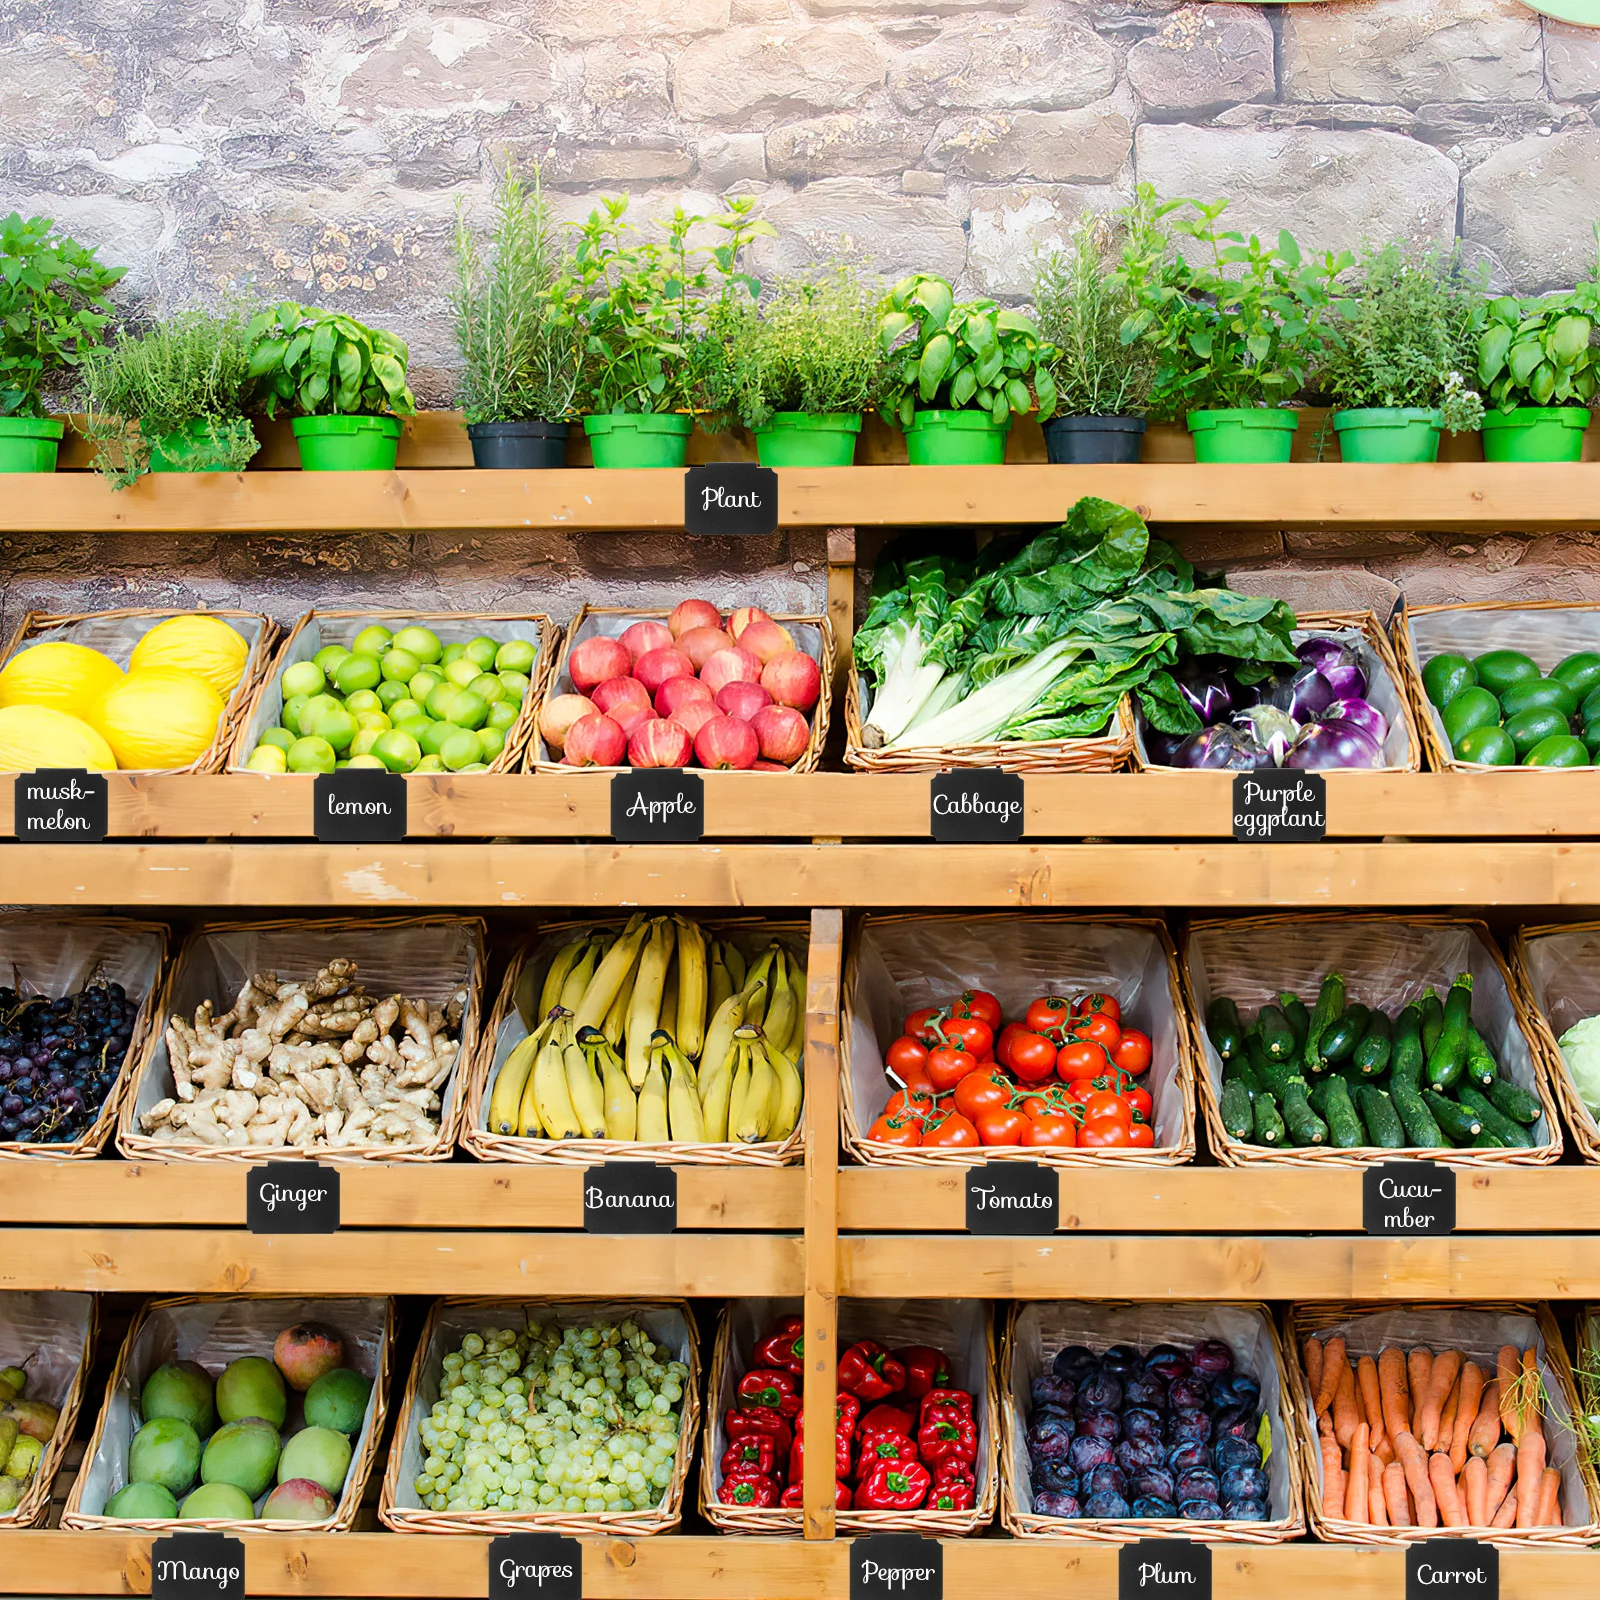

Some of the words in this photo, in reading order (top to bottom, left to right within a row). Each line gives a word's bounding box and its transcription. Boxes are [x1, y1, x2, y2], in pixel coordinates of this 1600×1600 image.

[701, 485, 762, 512] Plant
[27, 778, 96, 800] musk-
[1243, 780, 1316, 811] Purple
[328, 793, 392, 815] lemon
[626, 791, 697, 824] Apple
[933, 792, 1023, 824] Cabbage
[27, 808, 91, 830] melon
[1234, 805, 1326, 836] eggplant
[259, 1183, 328, 1212] Ginger
[585, 1186, 675, 1210] Banana
[971, 1184, 1053, 1211] Tomato
[1378, 1177, 1443, 1200] Cucu-
[1384, 1206, 1436, 1228] mber
[157, 1560, 240, 1590] Mango
[499, 1558, 573, 1588] Grapes
[861, 1560, 936, 1591] Pepper
[1138, 1561, 1197, 1588] Plum
[1416, 1563, 1488, 1586] Carrot
